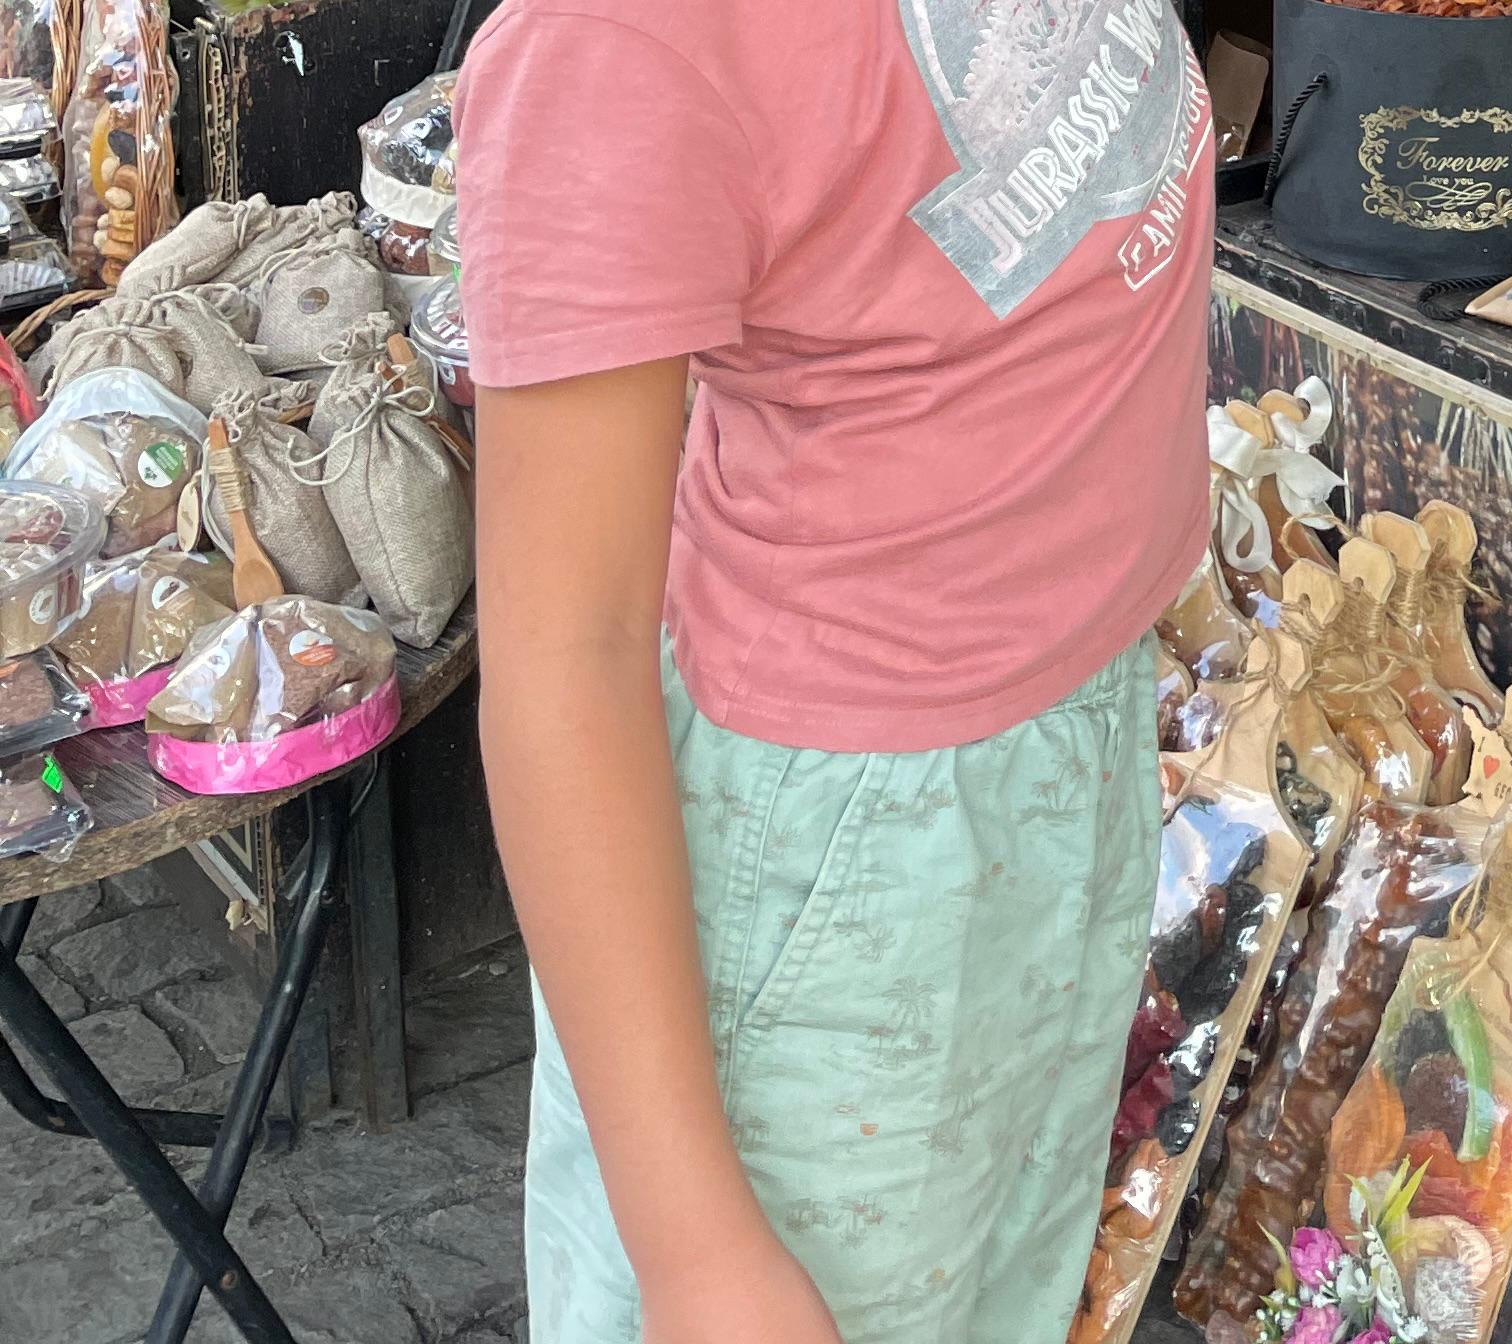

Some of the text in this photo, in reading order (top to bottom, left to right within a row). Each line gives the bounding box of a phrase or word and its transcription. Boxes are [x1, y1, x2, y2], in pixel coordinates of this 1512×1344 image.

[957, 44, 1139, 275] JURASSIC
[1396, 136, 1510, 173] Forever
[1422, 175, 1475, 191] Love you
